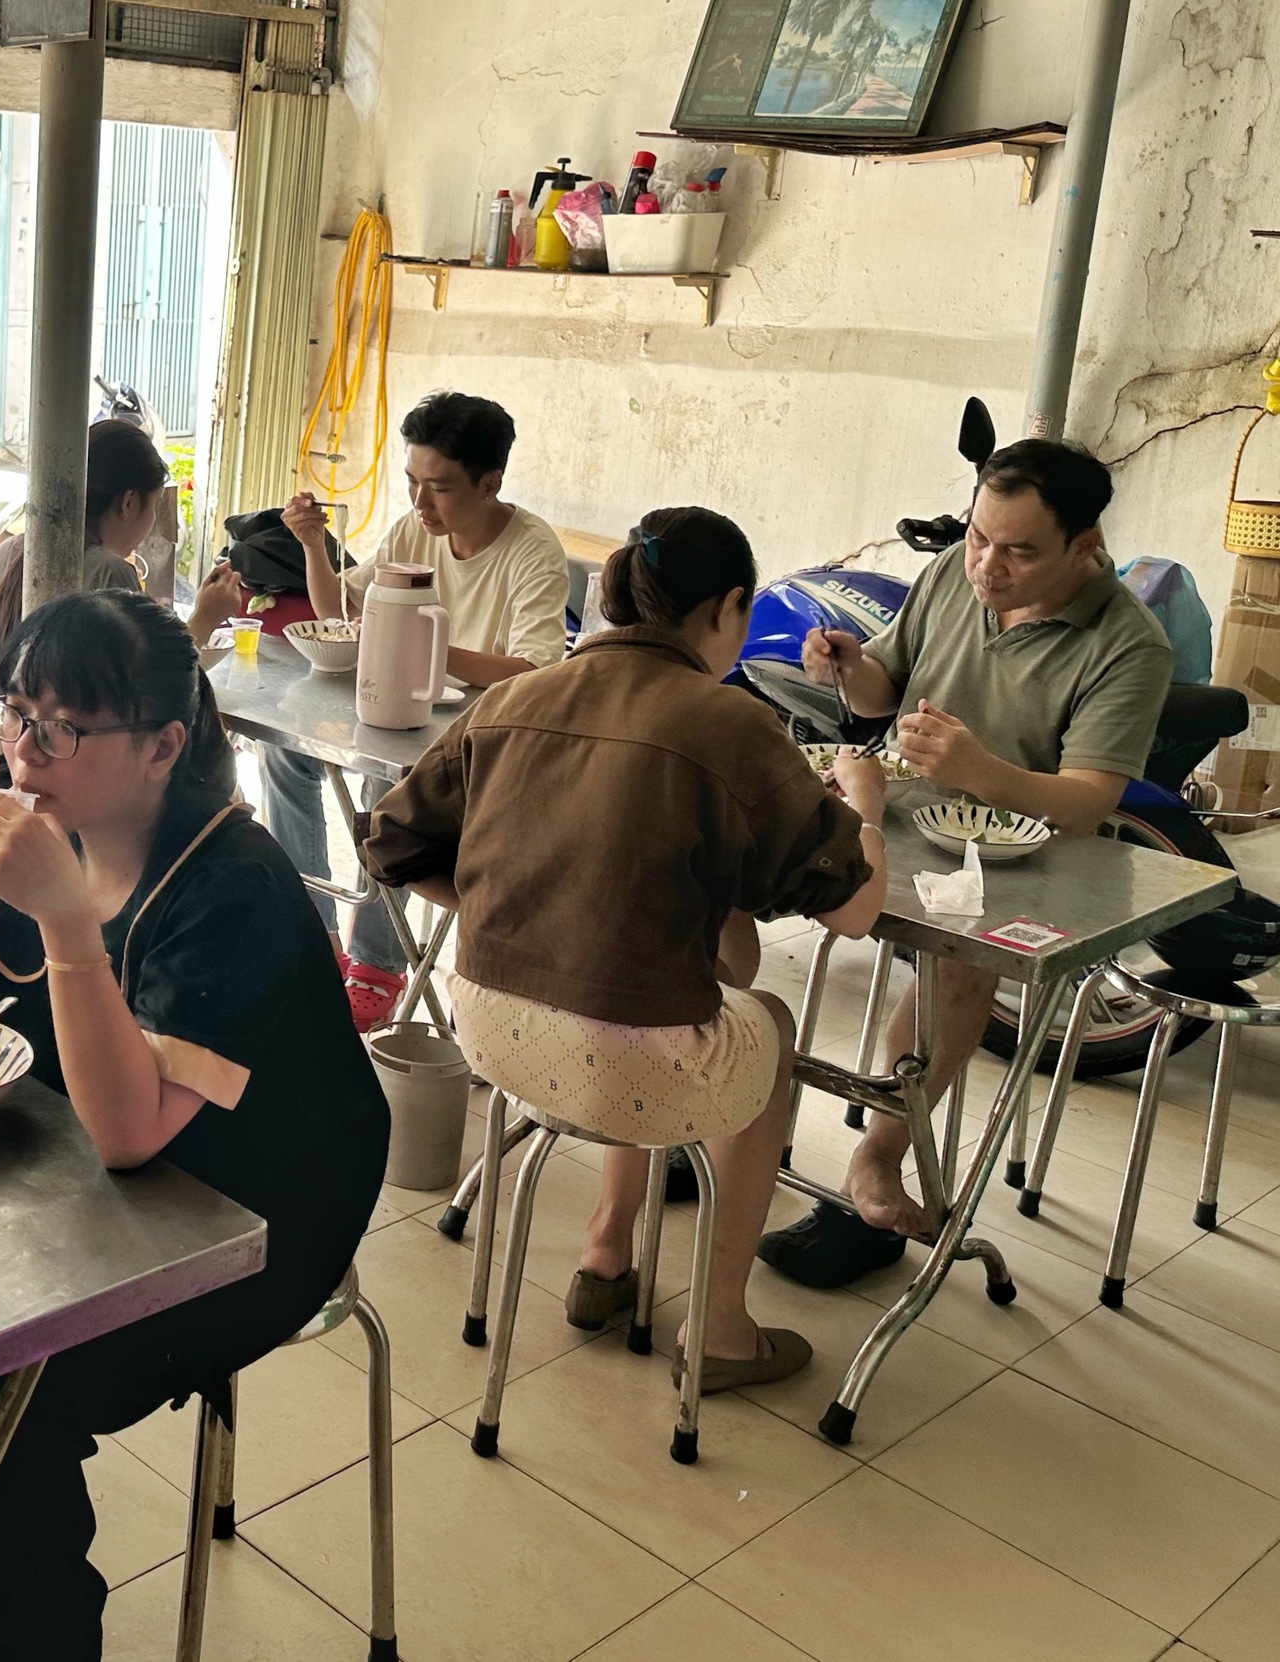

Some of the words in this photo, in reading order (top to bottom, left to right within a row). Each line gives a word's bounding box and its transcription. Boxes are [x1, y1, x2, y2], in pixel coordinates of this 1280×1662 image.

[823, 580, 895, 620] SUZUKI
[549, 1079, 558, 1091] B
[633, 1100, 643, 1111] B
